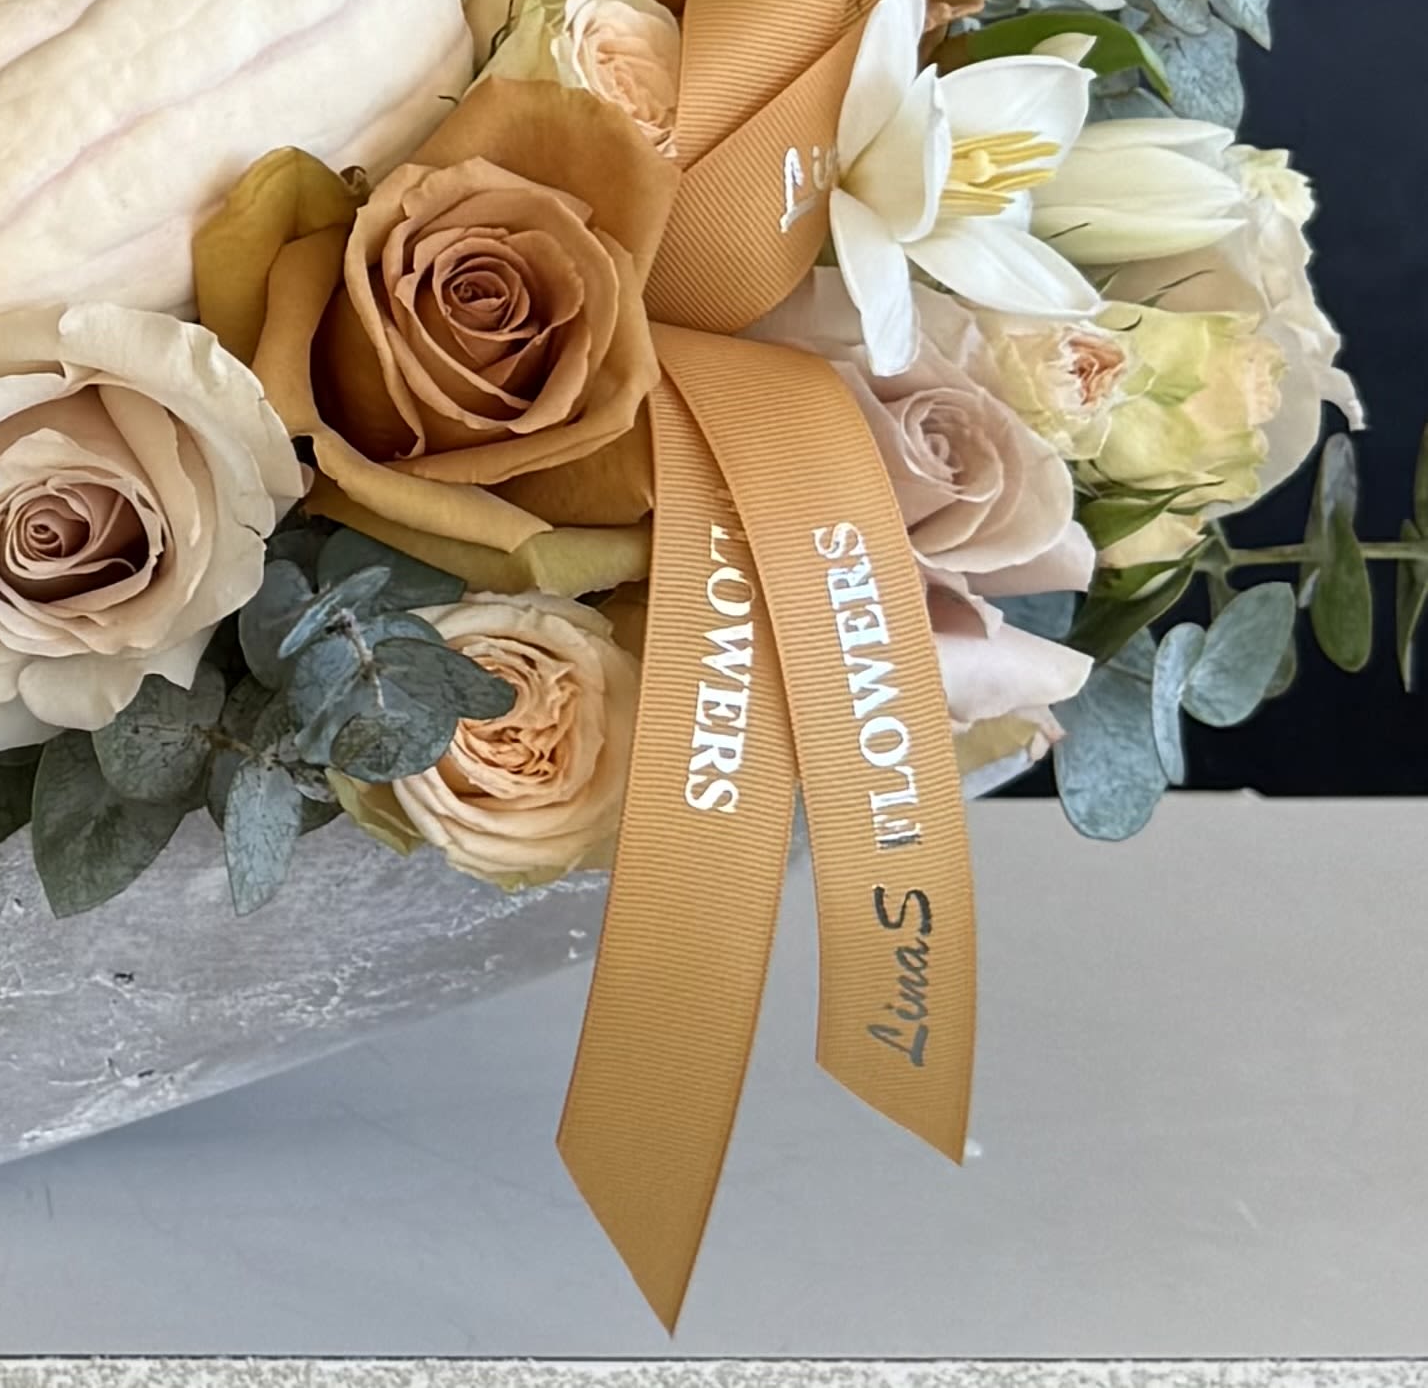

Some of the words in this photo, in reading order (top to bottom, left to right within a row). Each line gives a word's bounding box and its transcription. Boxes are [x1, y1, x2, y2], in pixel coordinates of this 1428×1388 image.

[684, 499, 758, 816] LOWERS
[813, 521, 924, 853] FLOWERS
[867, 883, 932, 1068] LinaS
